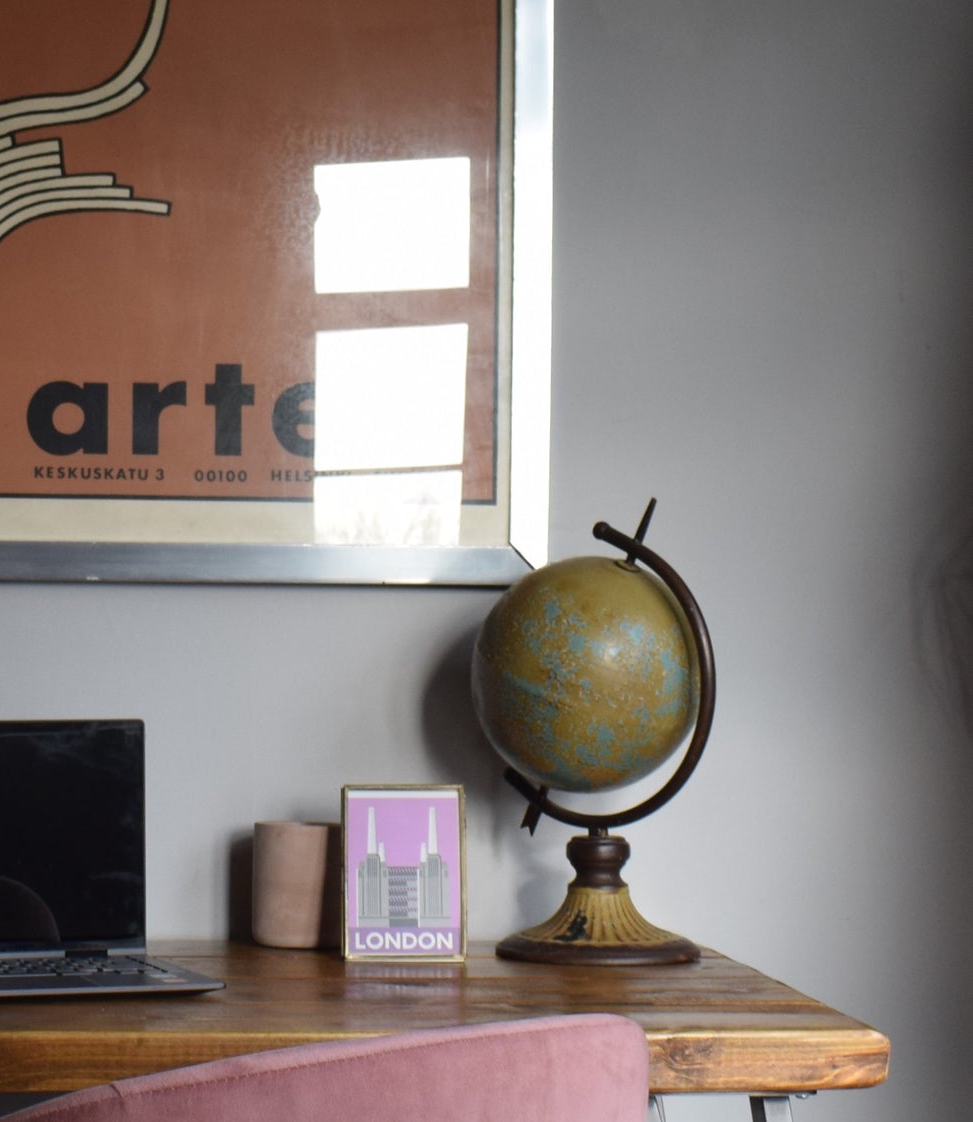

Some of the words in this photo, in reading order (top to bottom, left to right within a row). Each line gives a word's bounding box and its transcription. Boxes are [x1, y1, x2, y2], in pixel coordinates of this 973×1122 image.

[33, 466, 149, 481] KESKUSKATU
[155, 468, 165, 481] 3
[194, 470, 248, 482] 00100
[355, 932, 454, 950] LONDON
